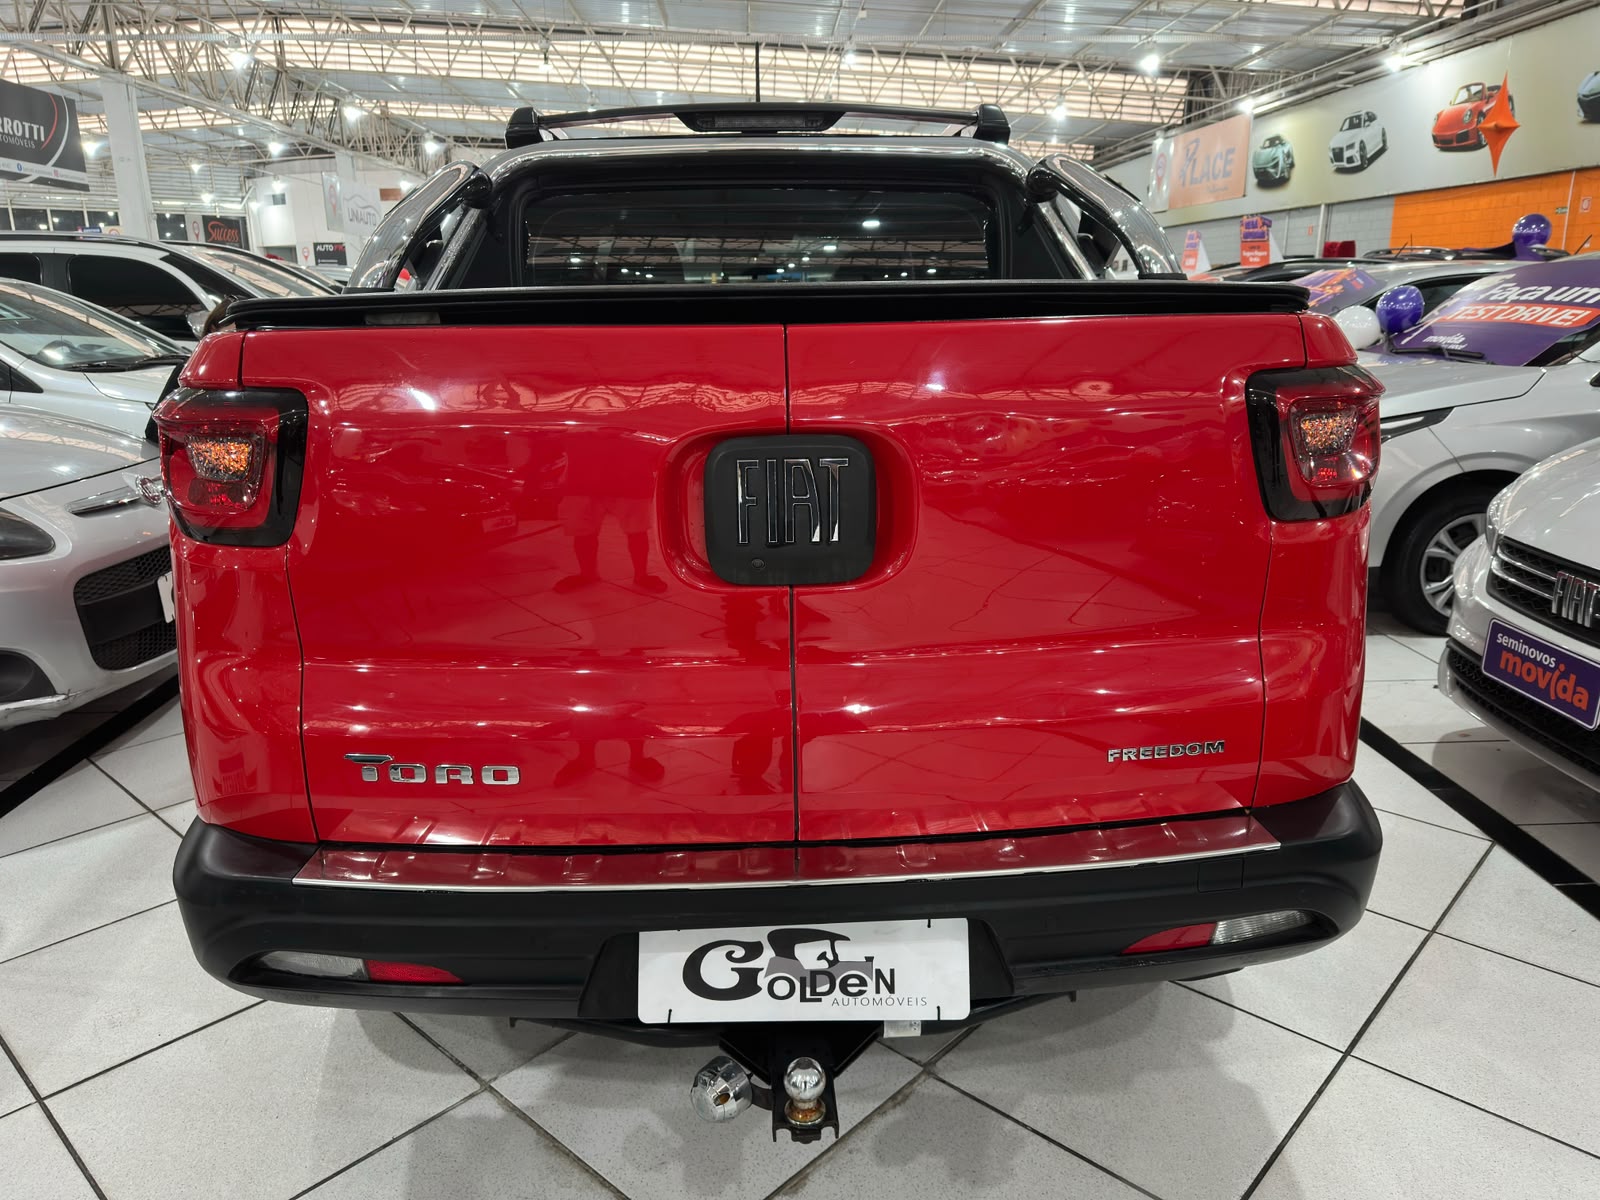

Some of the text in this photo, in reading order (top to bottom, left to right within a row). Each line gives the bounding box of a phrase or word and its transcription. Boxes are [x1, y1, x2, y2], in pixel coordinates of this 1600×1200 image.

[316, 244, 334, 252] AUTO
[1476, 282, 1600, 304] Faça um
[1447, 305, 1592, 326] TEST DRIVE!
[736, 457, 849, 544] FIAT
[1551, 571, 1600, 627] FIAT
[1496, 631, 1556, 668] seminovos
[1499, 649, 1589, 710] movida
[1107, 739, 1226, 763] FREEDOM
[343, 753, 520, 785] TORO
[831, 995, 928, 1007] AUTOMÓVEIS
